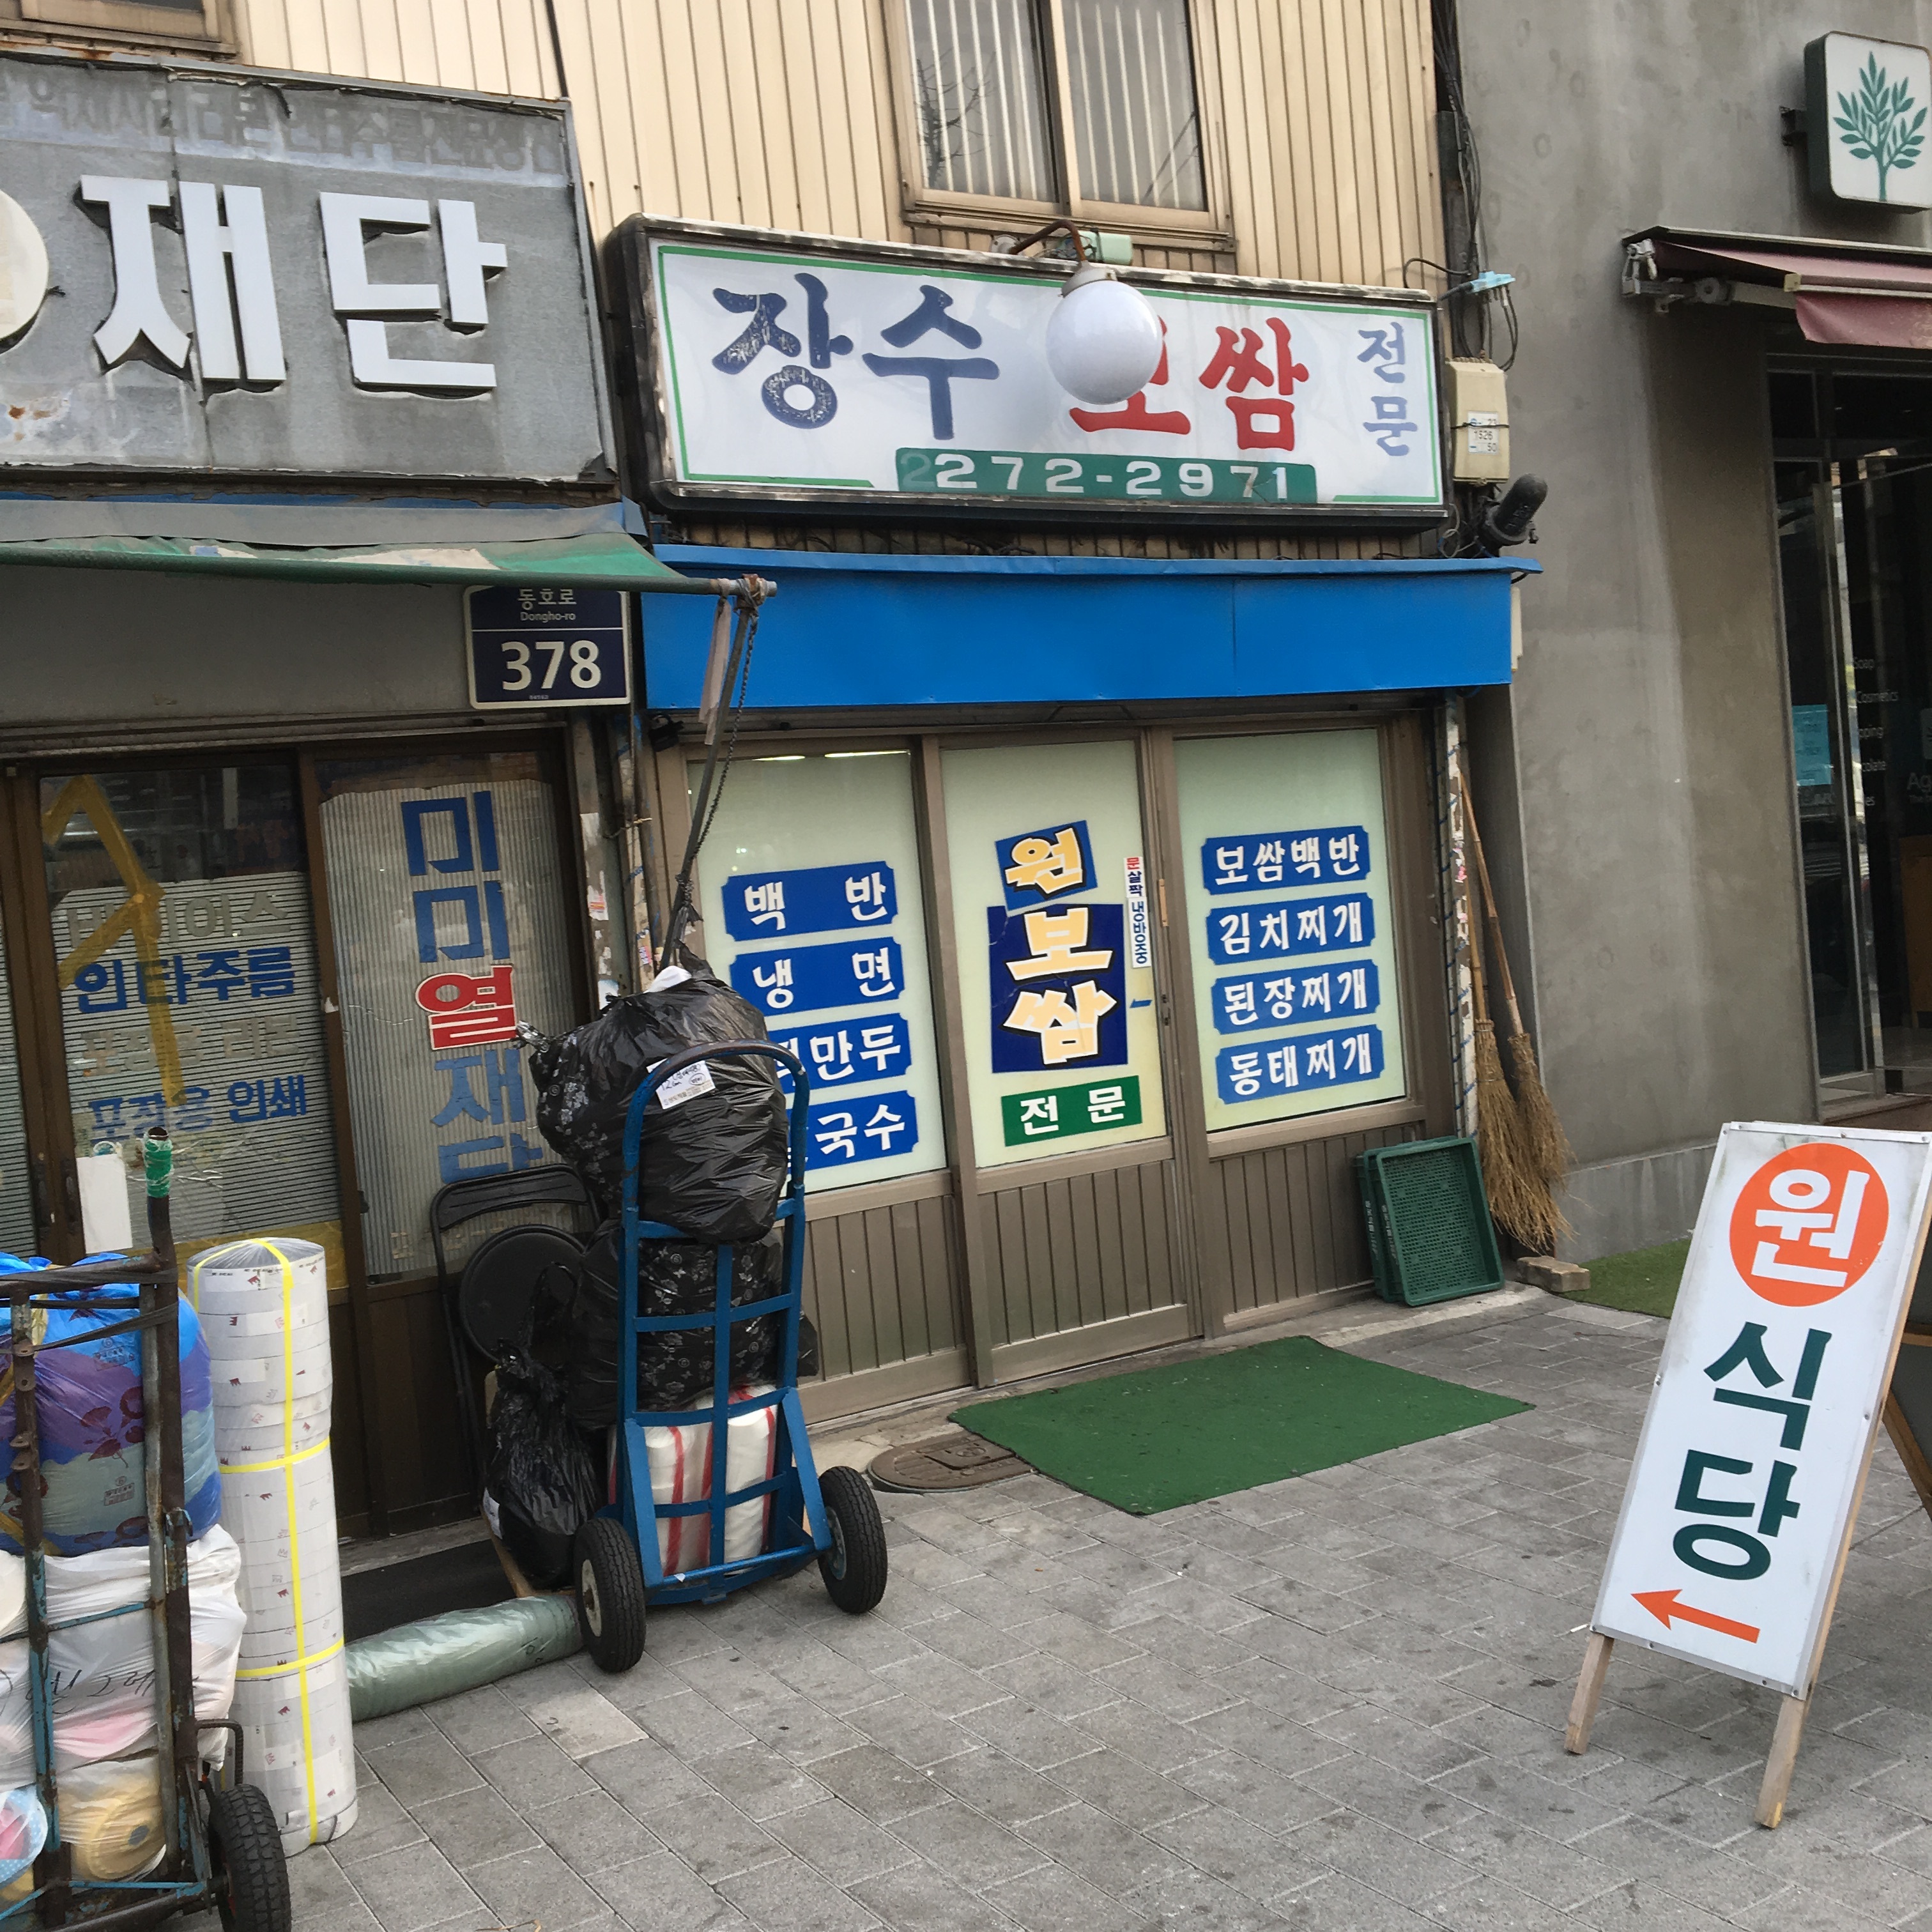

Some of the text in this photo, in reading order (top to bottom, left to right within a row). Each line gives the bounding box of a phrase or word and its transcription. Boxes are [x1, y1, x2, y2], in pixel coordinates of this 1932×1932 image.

[80, 174, 508, 388] 재단
[712, 272, 1000, 441] 장수
[1356, 321, 1418, 457] 전문
[518, 588, 577, 610] 동호로
[520, 611, 576, 623] Dongho-ro
[501, 640, 602, 691] 378
[1215, 833, 1360, 885] 보쌈백반
[1219, 901, 1363, 955] 김치찌개
[75, 946, 295, 1014] 인타주름
[1223, 968, 1367, 1025] 된장찌개
[1229, 1032, 1373, 1096] 동태찌개
[227, 1075, 307, 1123] 인쇄
[787, 1104, 905, 1169] 국수
